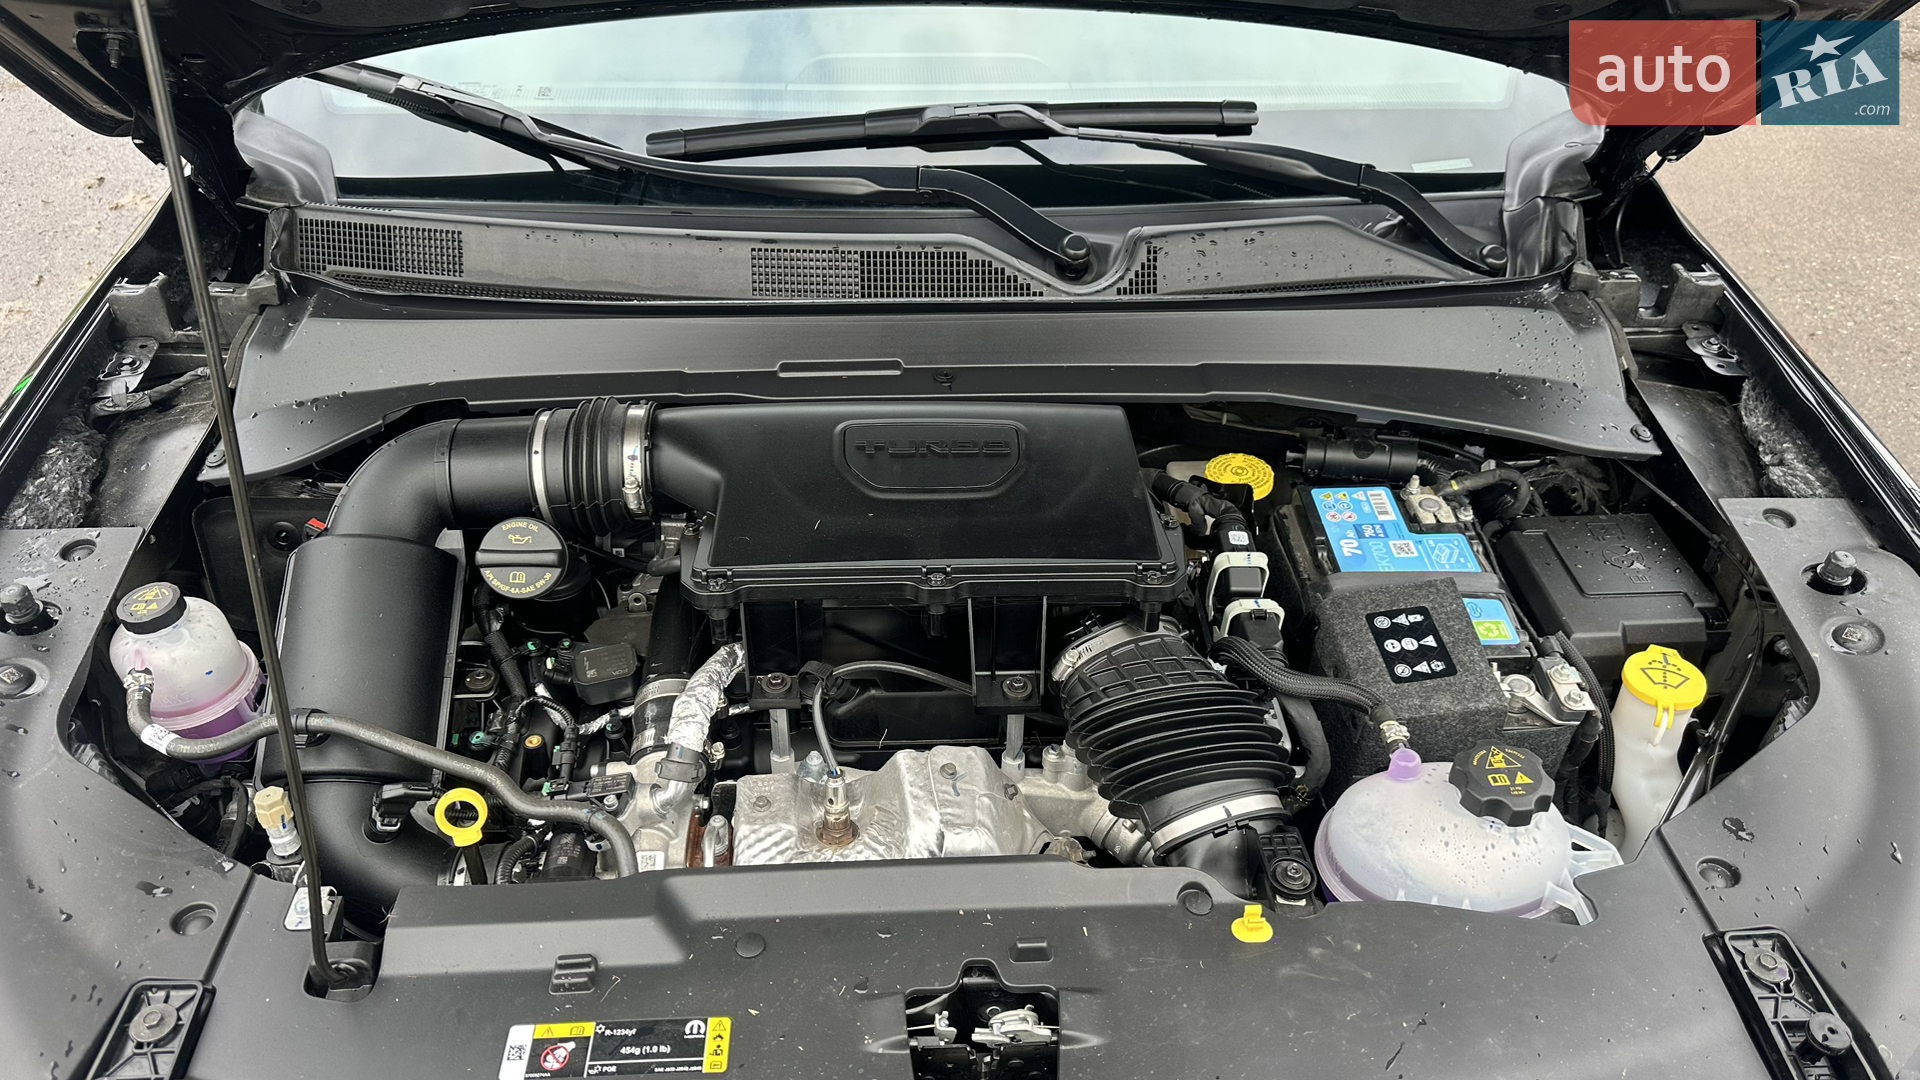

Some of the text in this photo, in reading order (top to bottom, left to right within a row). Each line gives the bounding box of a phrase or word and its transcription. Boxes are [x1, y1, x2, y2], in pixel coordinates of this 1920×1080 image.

[855, 439, 1011, 455] TURBO
[501, 521, 539, 532] ENGINE OIL
[1361, 524, 1376, 538] 760
[1339, 529, 1363, 557] 70 Ah
[1368, 541, 1395, 572] EK700
[484, 569, 494, 581] API
[535, 573, 552, 588] 5W-30
[604, 1028, 637, 1037] R-1234yf
[619, 1044, 671, 1056] 454g (1.0 lb)
[602, 1065, 617, 1073] POE
